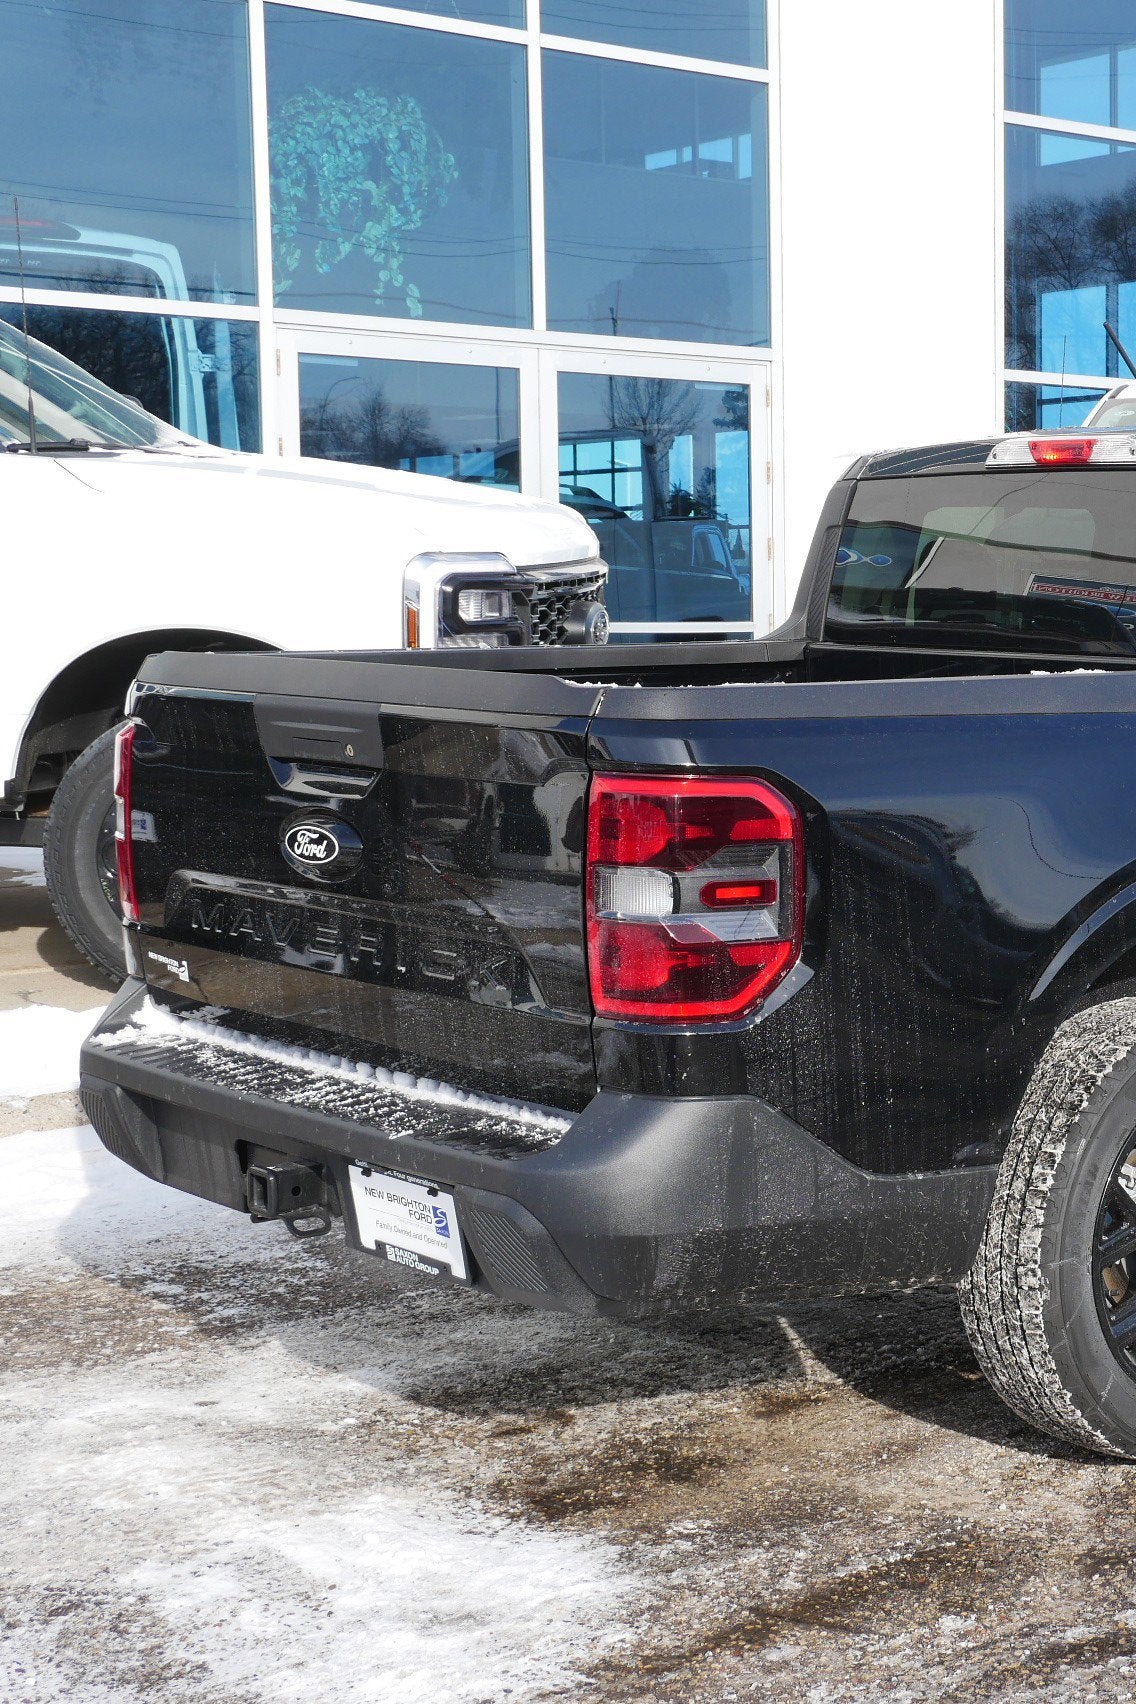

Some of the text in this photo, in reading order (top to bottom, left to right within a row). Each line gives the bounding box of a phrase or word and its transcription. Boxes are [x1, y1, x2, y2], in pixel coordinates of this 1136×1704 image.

[294, 830, 327, 859] Ford
[364, 1186, 431, 1213] NEW BRIGHTON
[408, 1209, 433, 1225] FORD
[375, 1219, 393, 1233] Family
[393, 1226, 412, 1238] Owned
[412, 1231, 423, 1241] and
[395, 1247, 419, 1262] SAXON
[396, 1255, 440, 1276] AUTO GROUP
